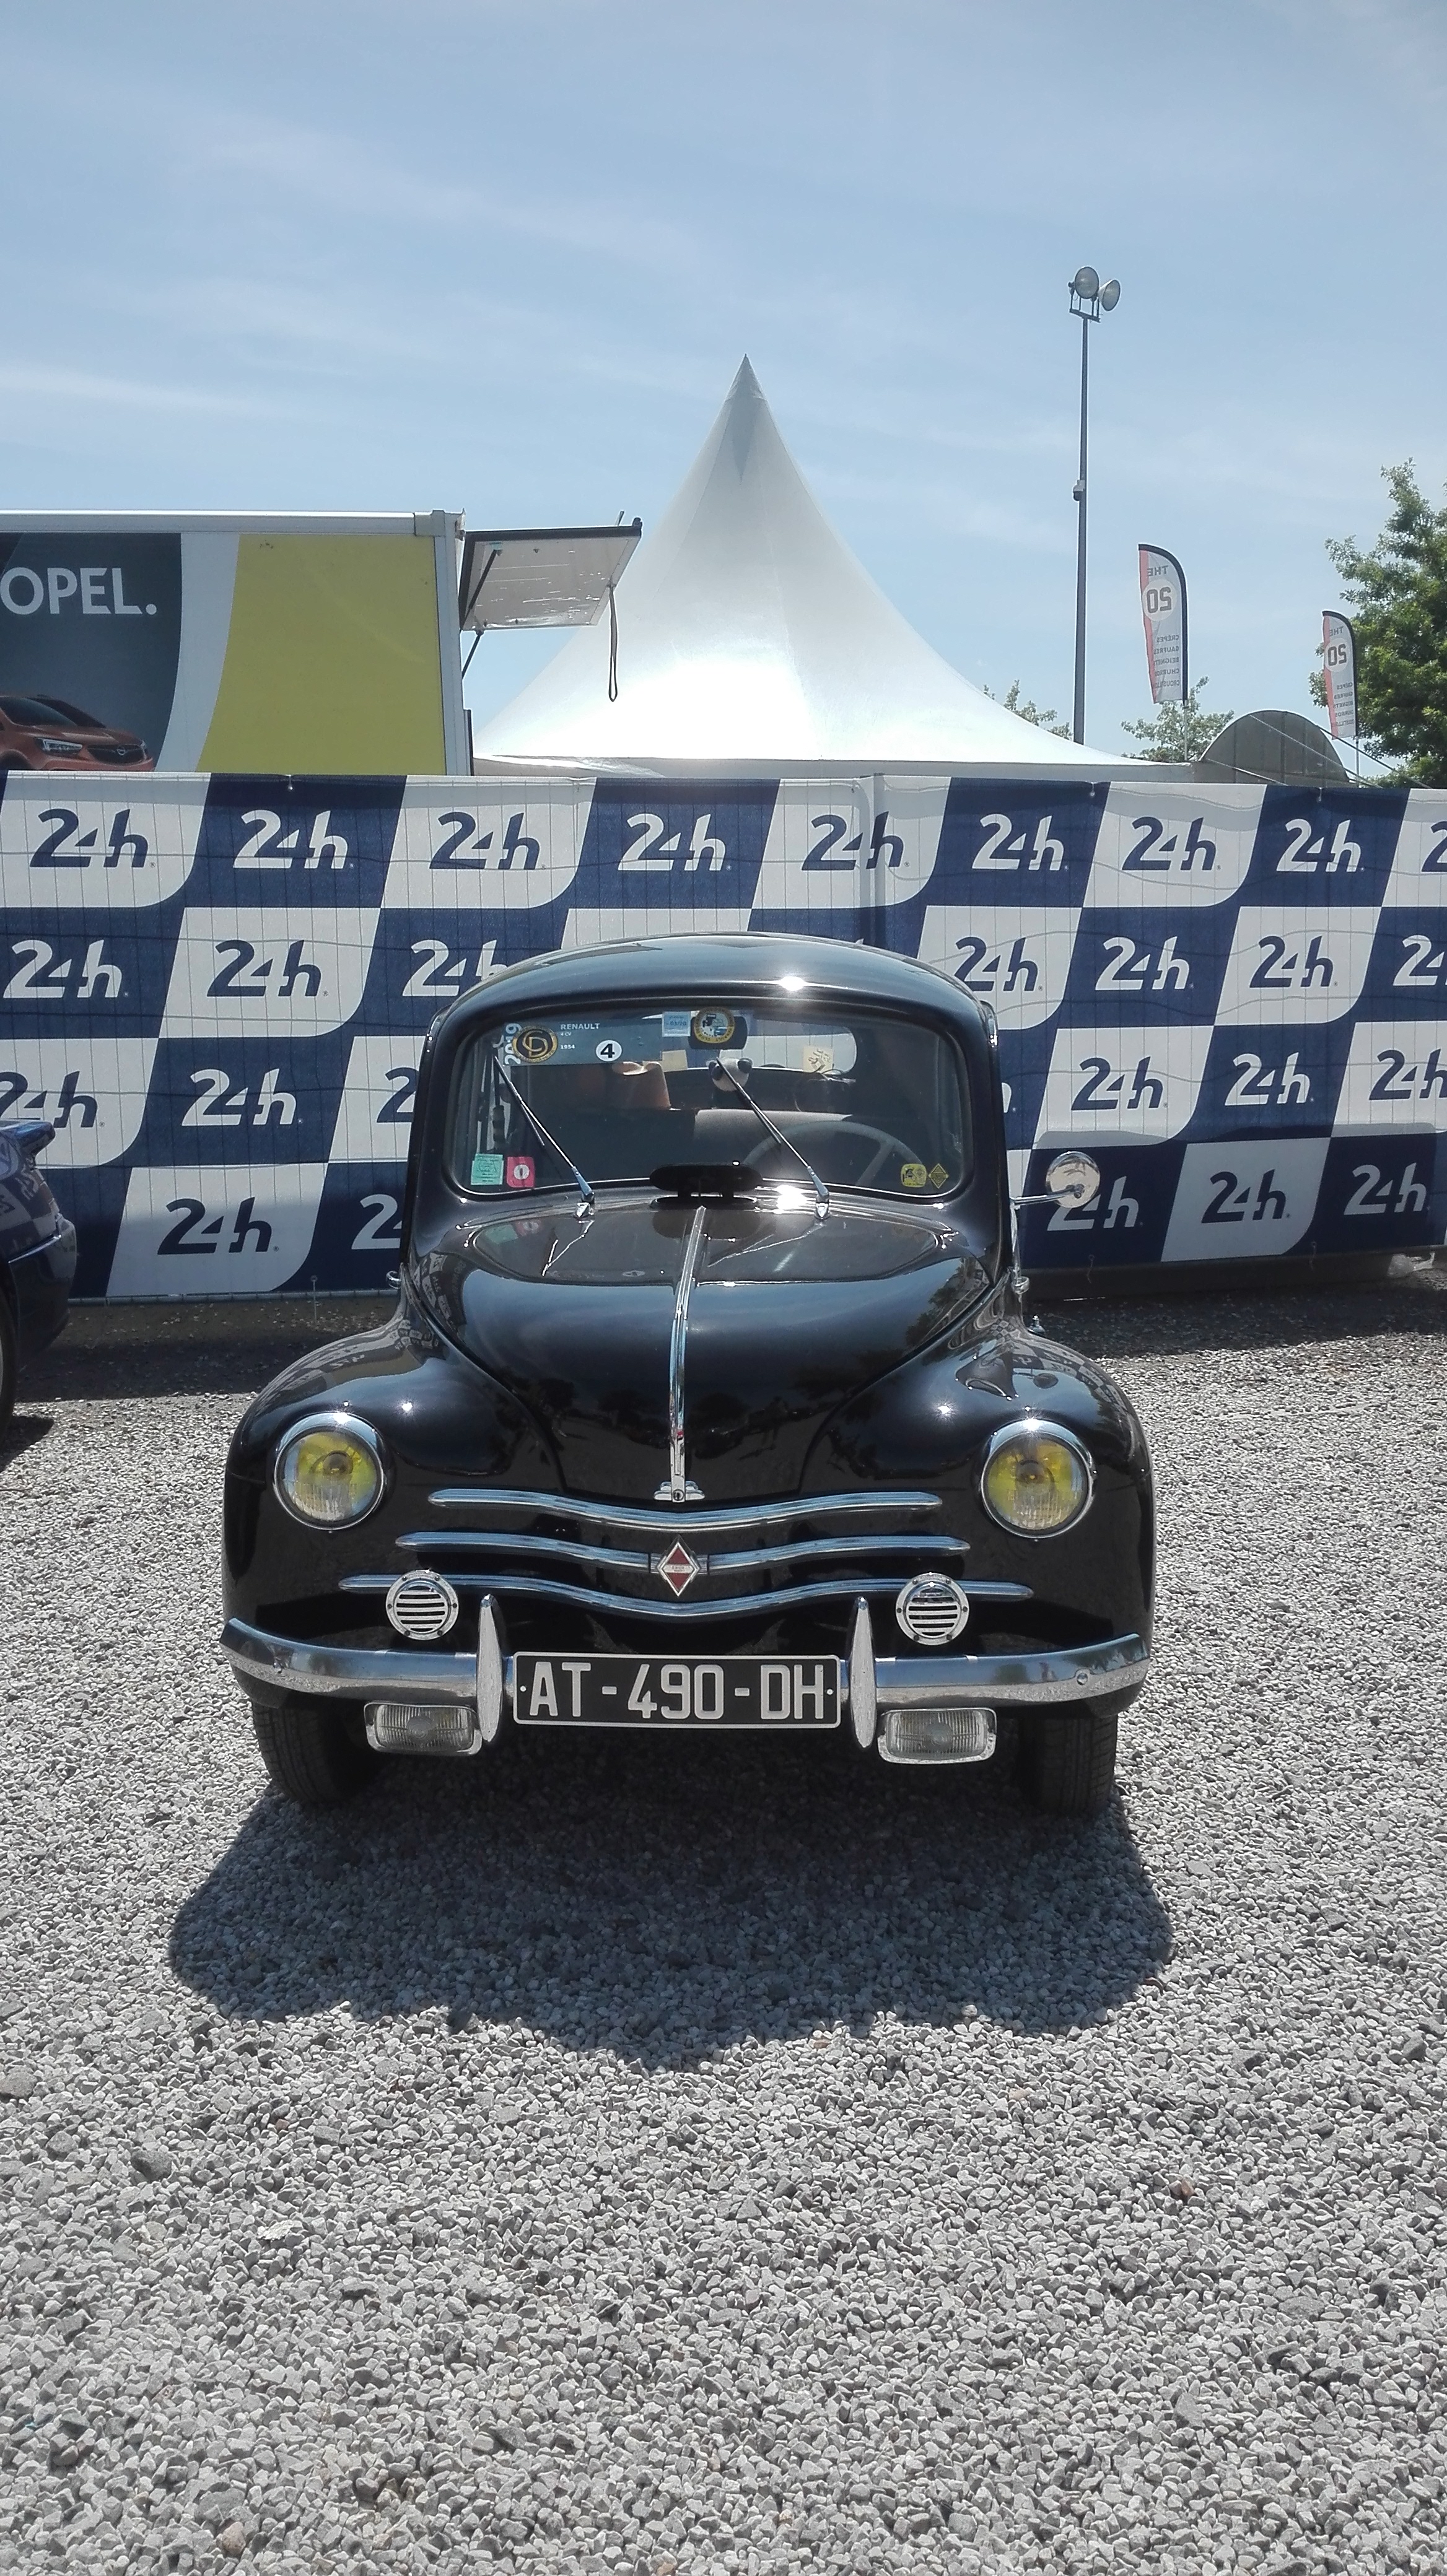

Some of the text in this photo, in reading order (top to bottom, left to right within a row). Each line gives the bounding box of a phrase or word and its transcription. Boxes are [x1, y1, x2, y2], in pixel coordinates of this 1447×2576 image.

[0, 567, 157, 616] OPEL.
[30, 808, 149, 868] 24h
[233, 809, 349, 869] 24h
[429, 812, 541, 870] 24h
[618, 813, 727, 871] 24h
[802, 811, 904, 871] 24h
[972, 813, 1065, 871] 24h
[1122, 816, 1217, 871] 24h
[1276, 819, 1362, 872] 24h
[2, 939, 123, 998] 24h
[207, 939, 321, 998] 24h
[954, 936, 1038, 991] 24h
[1095, 936, 1189, 991] 24h
[1249, 935, 1334, 988] 24h
[1392, 934, 1447, 987] 24
[600, 1043, 616, 1059] 4
[1225, 1051, 1310, 1106] 24h
[1368, 1048, 1447, 1100] 24h
[0, 1071, 98, 1128] 24h
[181, 1068, 297, 1126] 24h
[1071, 1056, 1163, 1111] 24h
[1201, 1168, 1287, 1224] 24h
[1344, 1162, 1427, 1216] 24h
[157, 1196, 273, 1255] 24h
